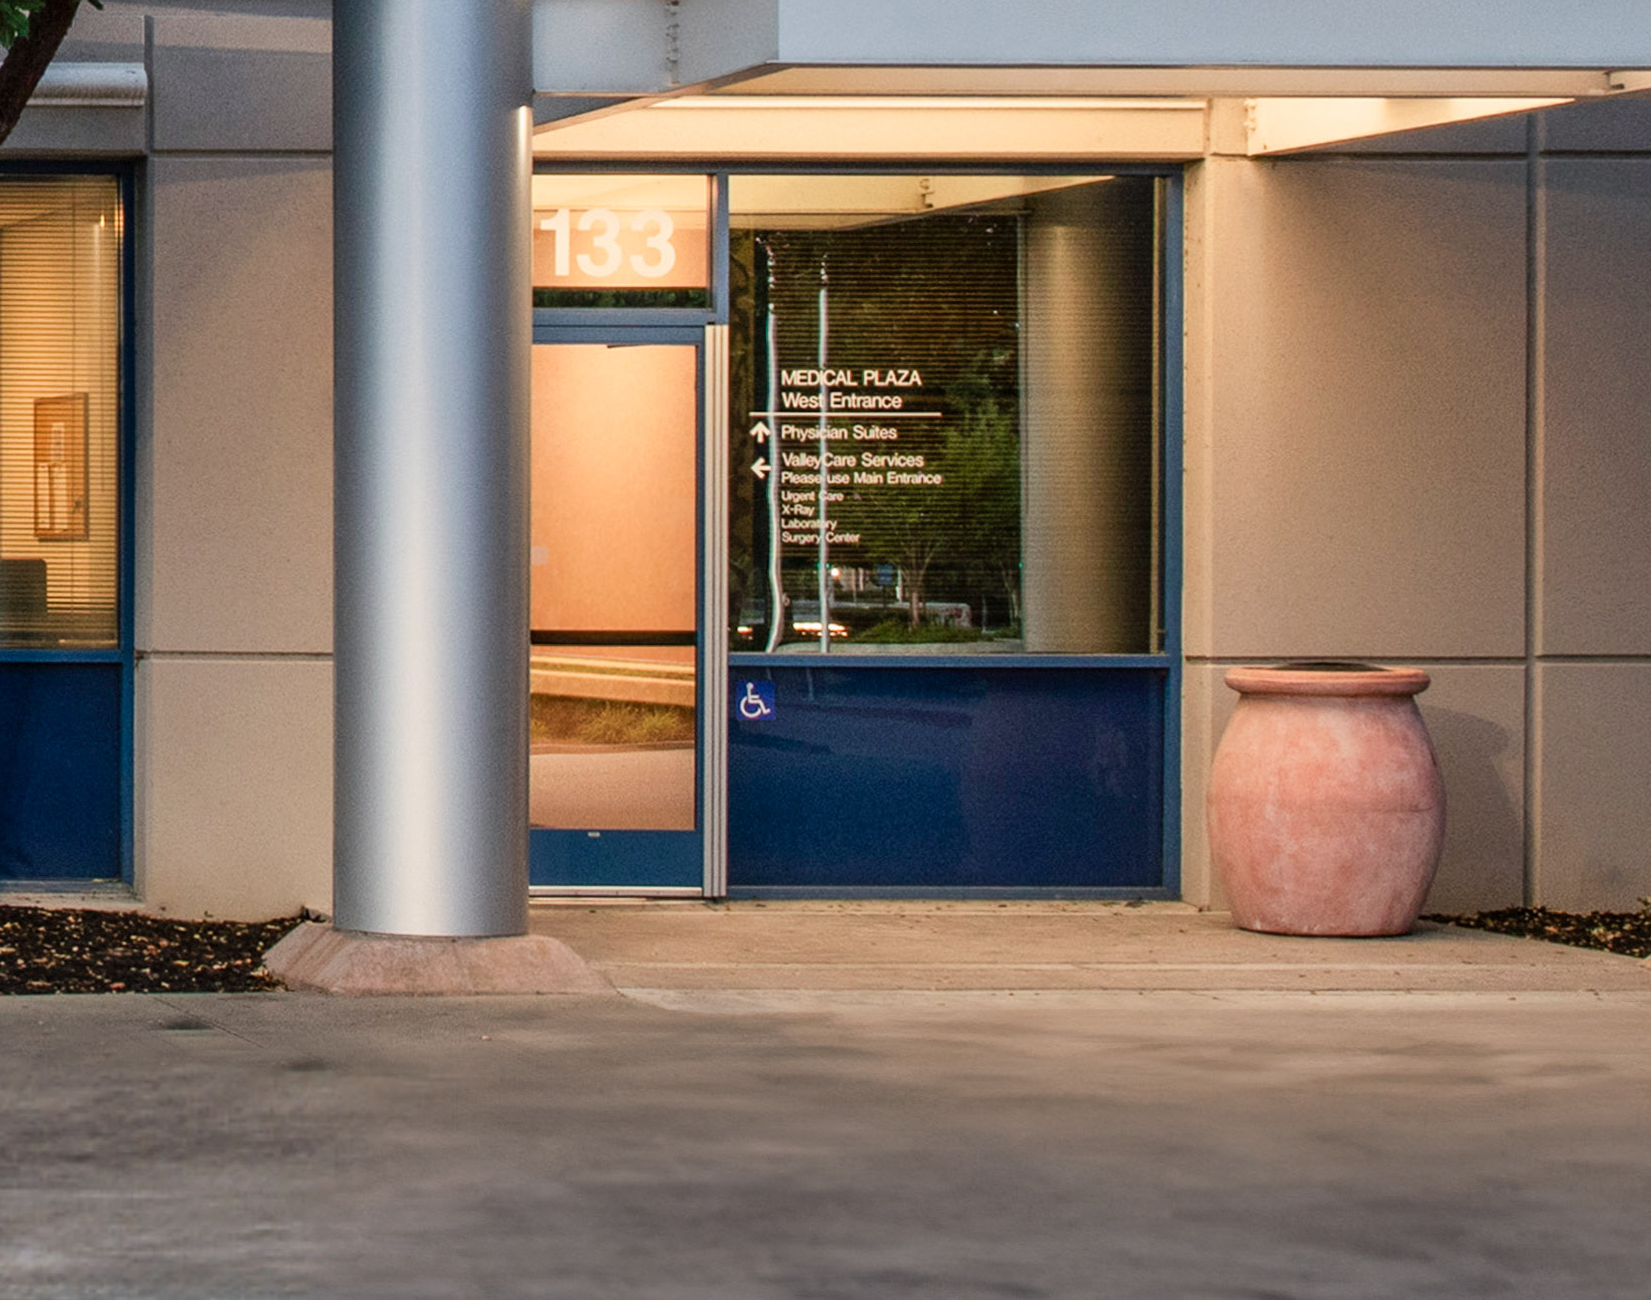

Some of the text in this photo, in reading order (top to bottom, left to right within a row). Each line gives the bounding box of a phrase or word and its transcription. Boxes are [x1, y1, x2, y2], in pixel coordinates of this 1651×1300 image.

[539, 208, 676, 278] 133
[781, 369, 922, 387] MEDICAL PLAZA
[781, 391, 903, 409] West Entrance
[781, 425, 898, 442] Physician Suites
[781, 452, 925, 470] ValleyCare Services
[781, 471, 943, 485] Please use Main Entrance
[781, 490, 845, 503] Urgent Care
[781, 504, 816, 517] X-Ray
[781, 518, 838, 531] Laboratory
[781, 532, 861, 545] Surgery Center
